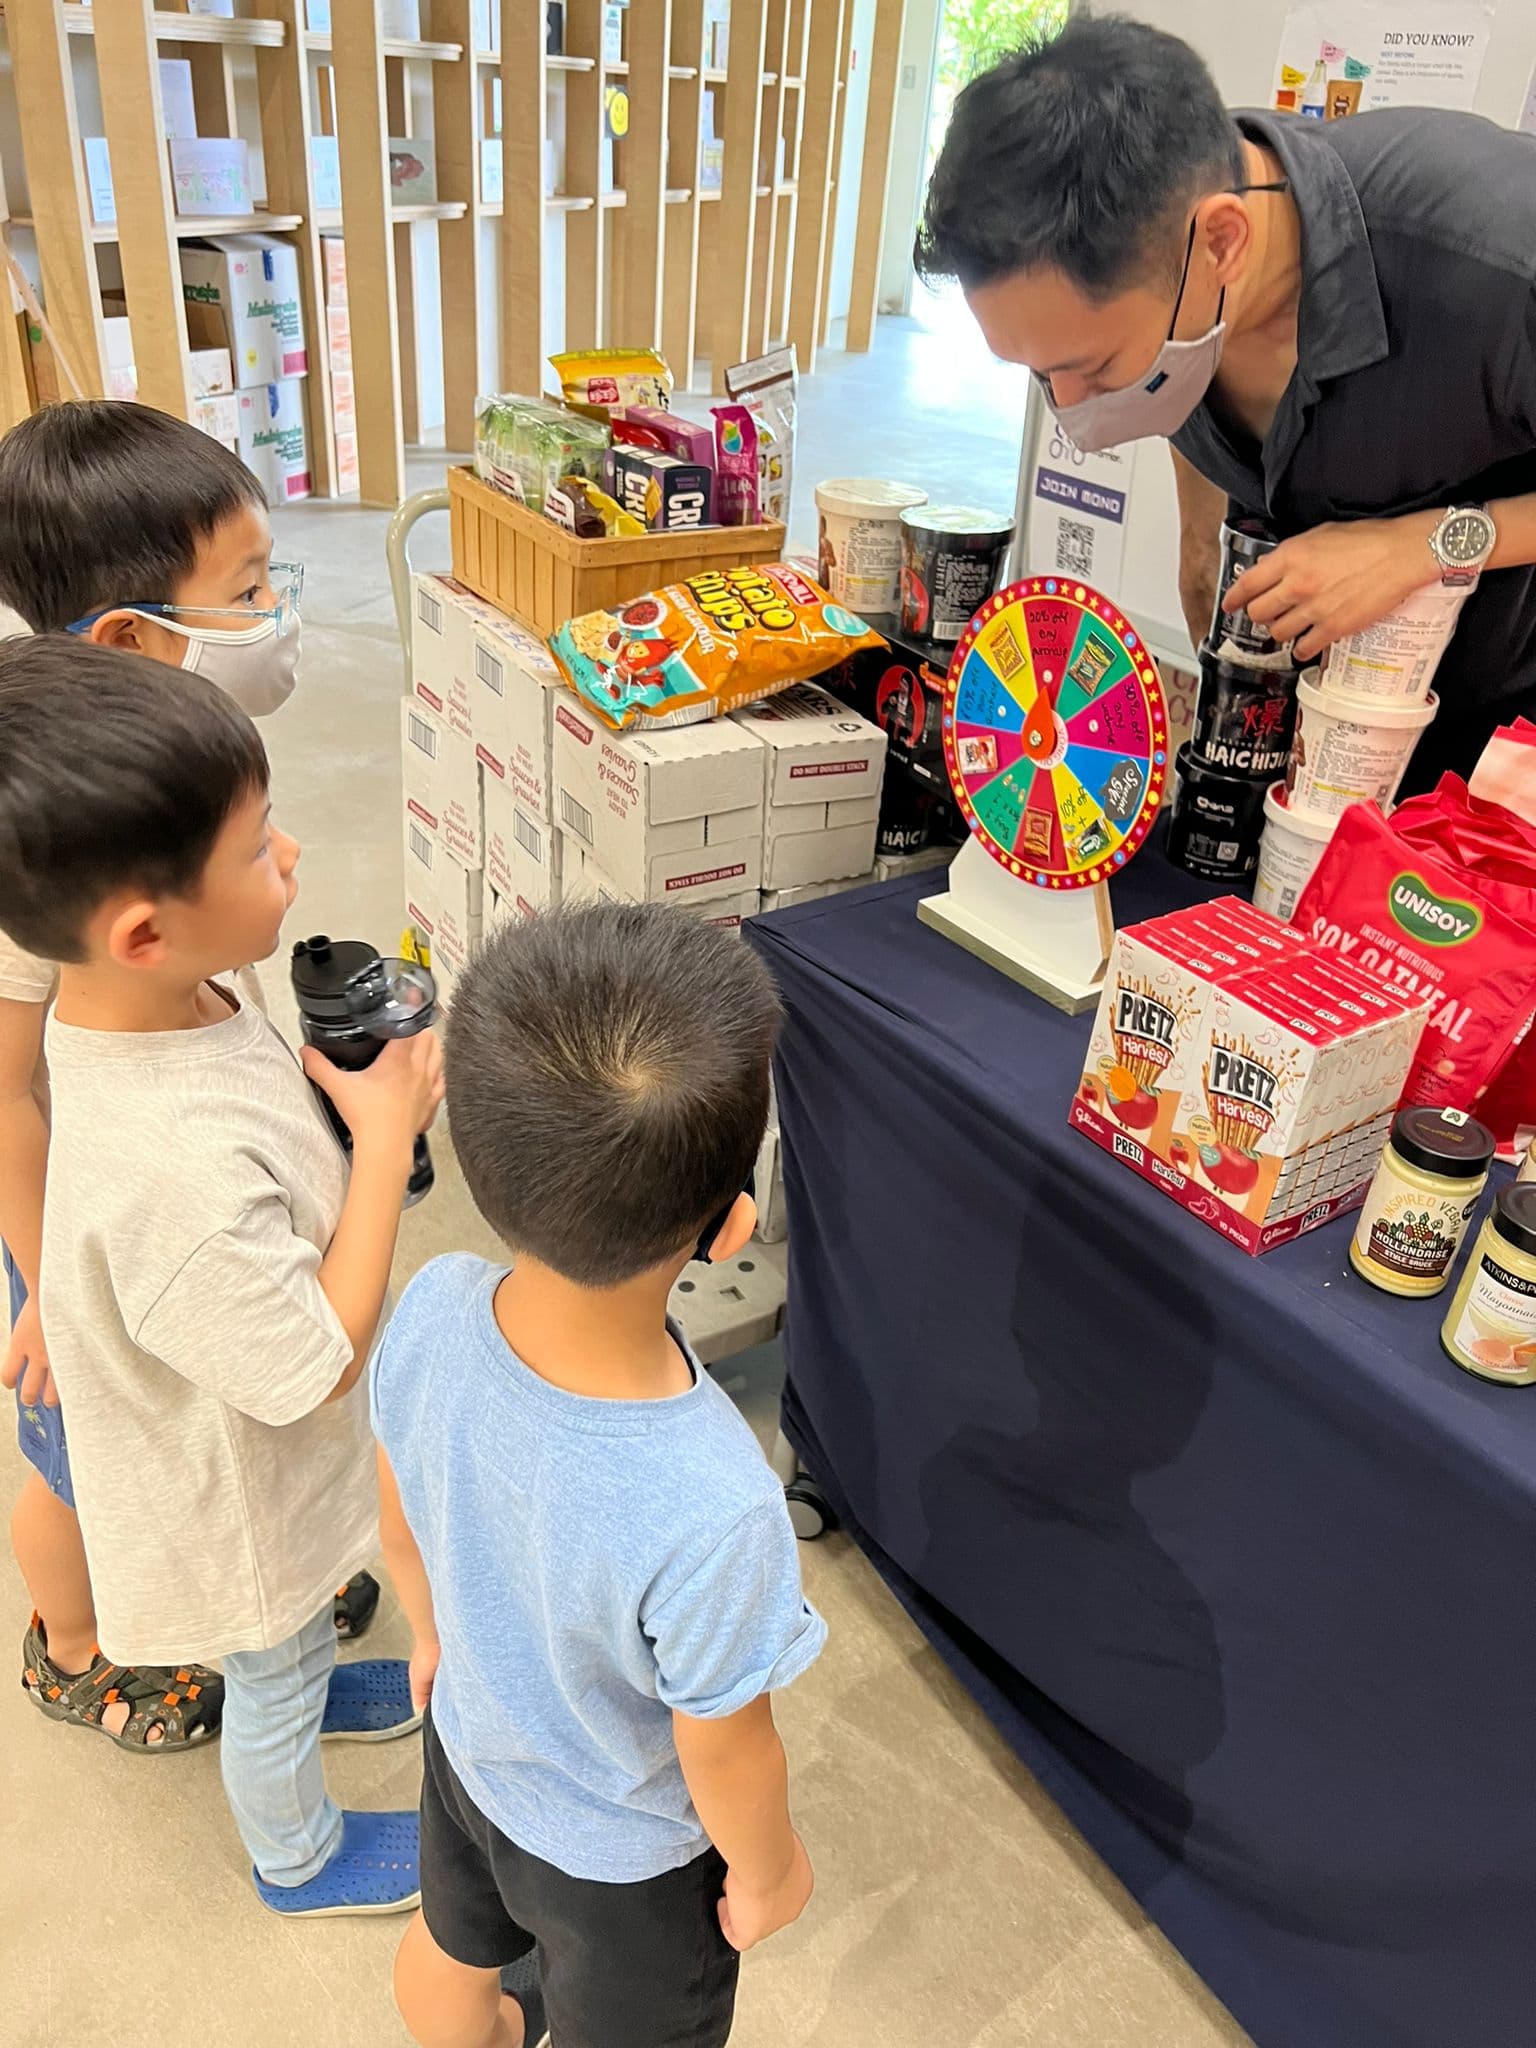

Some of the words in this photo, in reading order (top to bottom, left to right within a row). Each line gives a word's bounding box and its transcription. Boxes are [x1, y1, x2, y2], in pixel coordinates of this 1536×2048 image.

[1383, 33, 1404, 45] DID
[1406, 33, 1430, 46] YOU
[1431, 34, 1475, 47] KNOW?
[1040, 476, 1078, 500] JOIN
[509, 755, 534, 788] Sauces
[598, 761, 607, 780] &
[601, 743, 638, 783] Gravies
[793, 767, 803, 776] DO
[804, 766, 818, 775] NOT
[820, 763, 845, 774] DOUBLE
[847, 761, 866, 772] STACK
[512, 776, 540, 811] Gravies
[607, 768, 640, 806] Sauces
[442, 810, 468, 839] Sauces
[445, 827, 474, 858] Gravies
[668, 878, 689, 889] STACK
[690, 871, 718, 884] DOUBLE
[719, 867, 733, 878] NOT
[734, 865, 744, 874] DO
[1394, 885, 1471, 937] UNISOY
[1359, 923, 1398, 952] INSTANT
[1395, 945, 1445, 983] NUTRITIOUS
[1119, 993, 1175, 1046] PRETZ
[1122, 1036, 1170, 1067] Harvest
[1213, 1051, 1276, 1109] PRETZ
[1217, 1097, 1270, 1131] Harvest
[1115, 1136, 1142, 1163] PRETZ
[1153, 1161, 1186, 1189] Harvest
[1303, 1204, 1329, 1228] PRETZ
[1384, 1194, 1437, 1218] INSPIRED
[1439, 1201, 1461, 1235] VEGAN
[1375, 1231, 1448, 1259] HOLLANDAISE
[1385, 1250, 1407, 1263] STYLE
[1409, 1259, 1433, 1268] SAUCE
